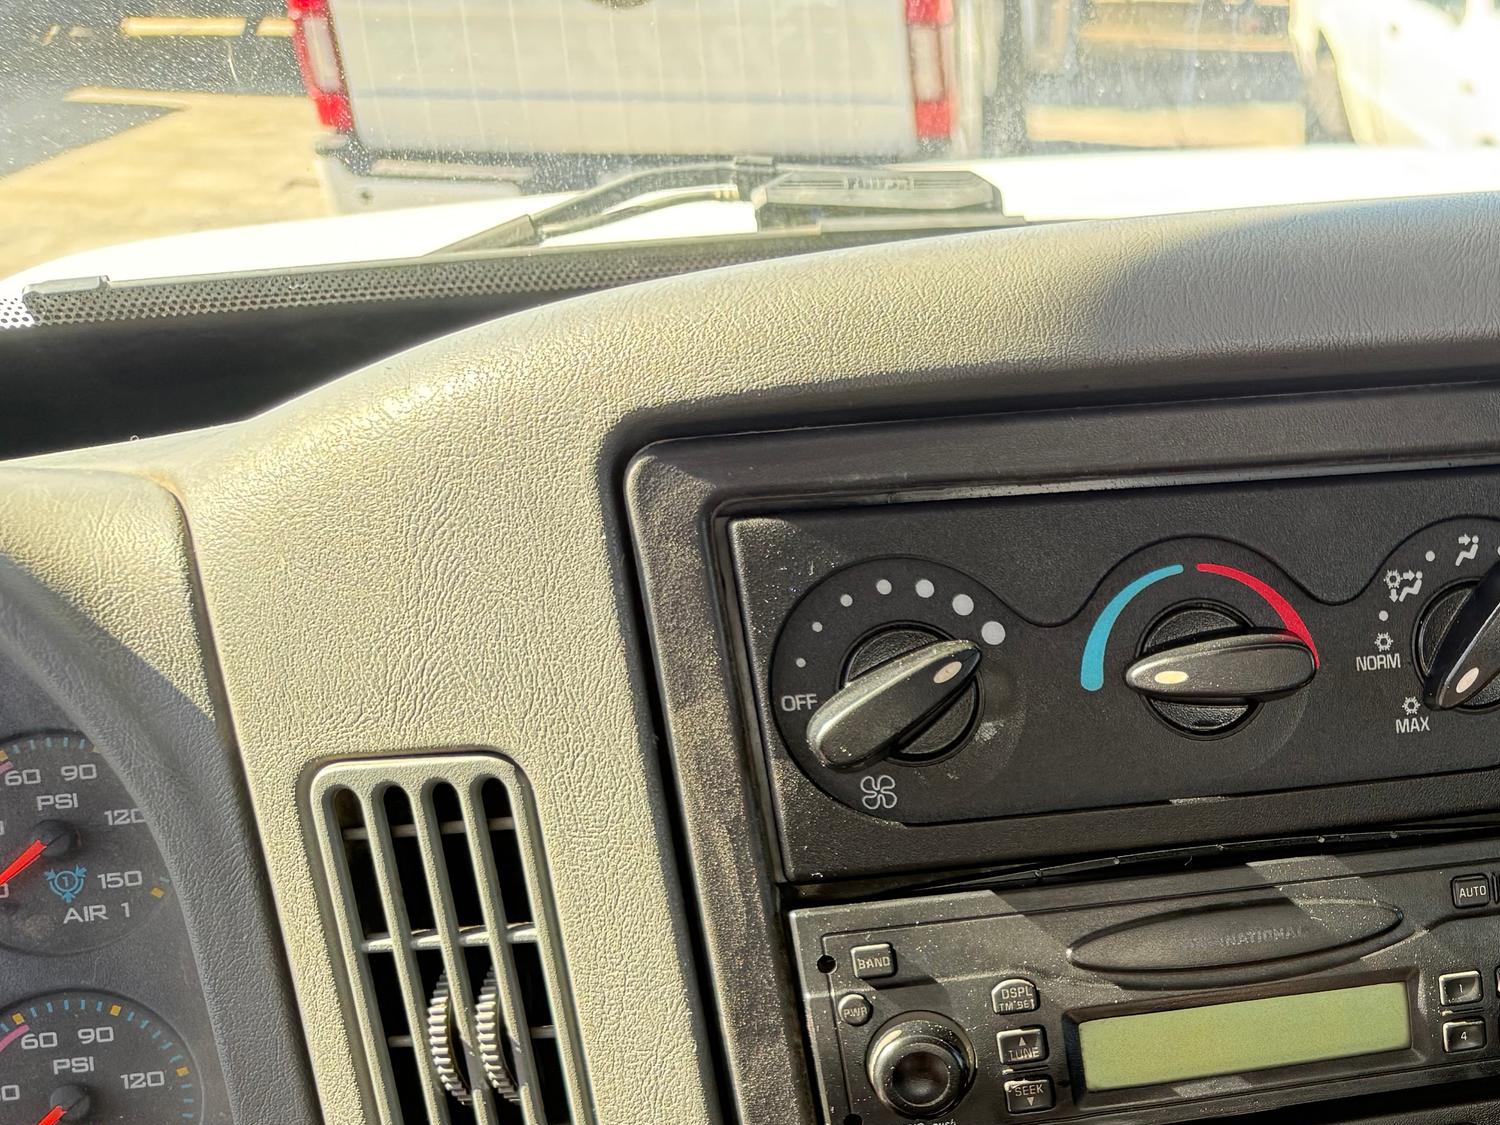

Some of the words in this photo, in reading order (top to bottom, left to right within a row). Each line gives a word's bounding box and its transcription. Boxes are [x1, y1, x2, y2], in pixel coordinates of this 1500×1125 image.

[1356, 653, 1401, 672] NORM
[781, 693, 818, 712] OFF
[1395, 716, 1430, 734] MAX
[5, 769, 41, 786] 60
[61, 764, 97, 781] 90
[36, 793, 78, 811] PSI
[104, 808, 146, 826] 120
[97, 870, 143, 889] 150
[1459, 885, 1487, 898] AUTO
[63, 904, 109, 924] AIR
[121, 902, 130, 918] 1
[858, 956, 890, 970] BAND
[1001, 986, 1033, 999] DSPL
[1457, 981, 1464, 993] 1
[843, 1005, 868, 1018] PWR
[21, 1032, 58, 1049] 60
[78, 1026, 114, 1044] 90
[1460, 1030, 1468, 1042] 4
[1008, 1047, 1041, 1061] TUNE
[53, 1056, 95, 1075] PSI
[120, 1071, 165, 1090] 120
[1, 1085, 20, 1100] 0
[1014, 1083, 1044, 1097] SEEK
